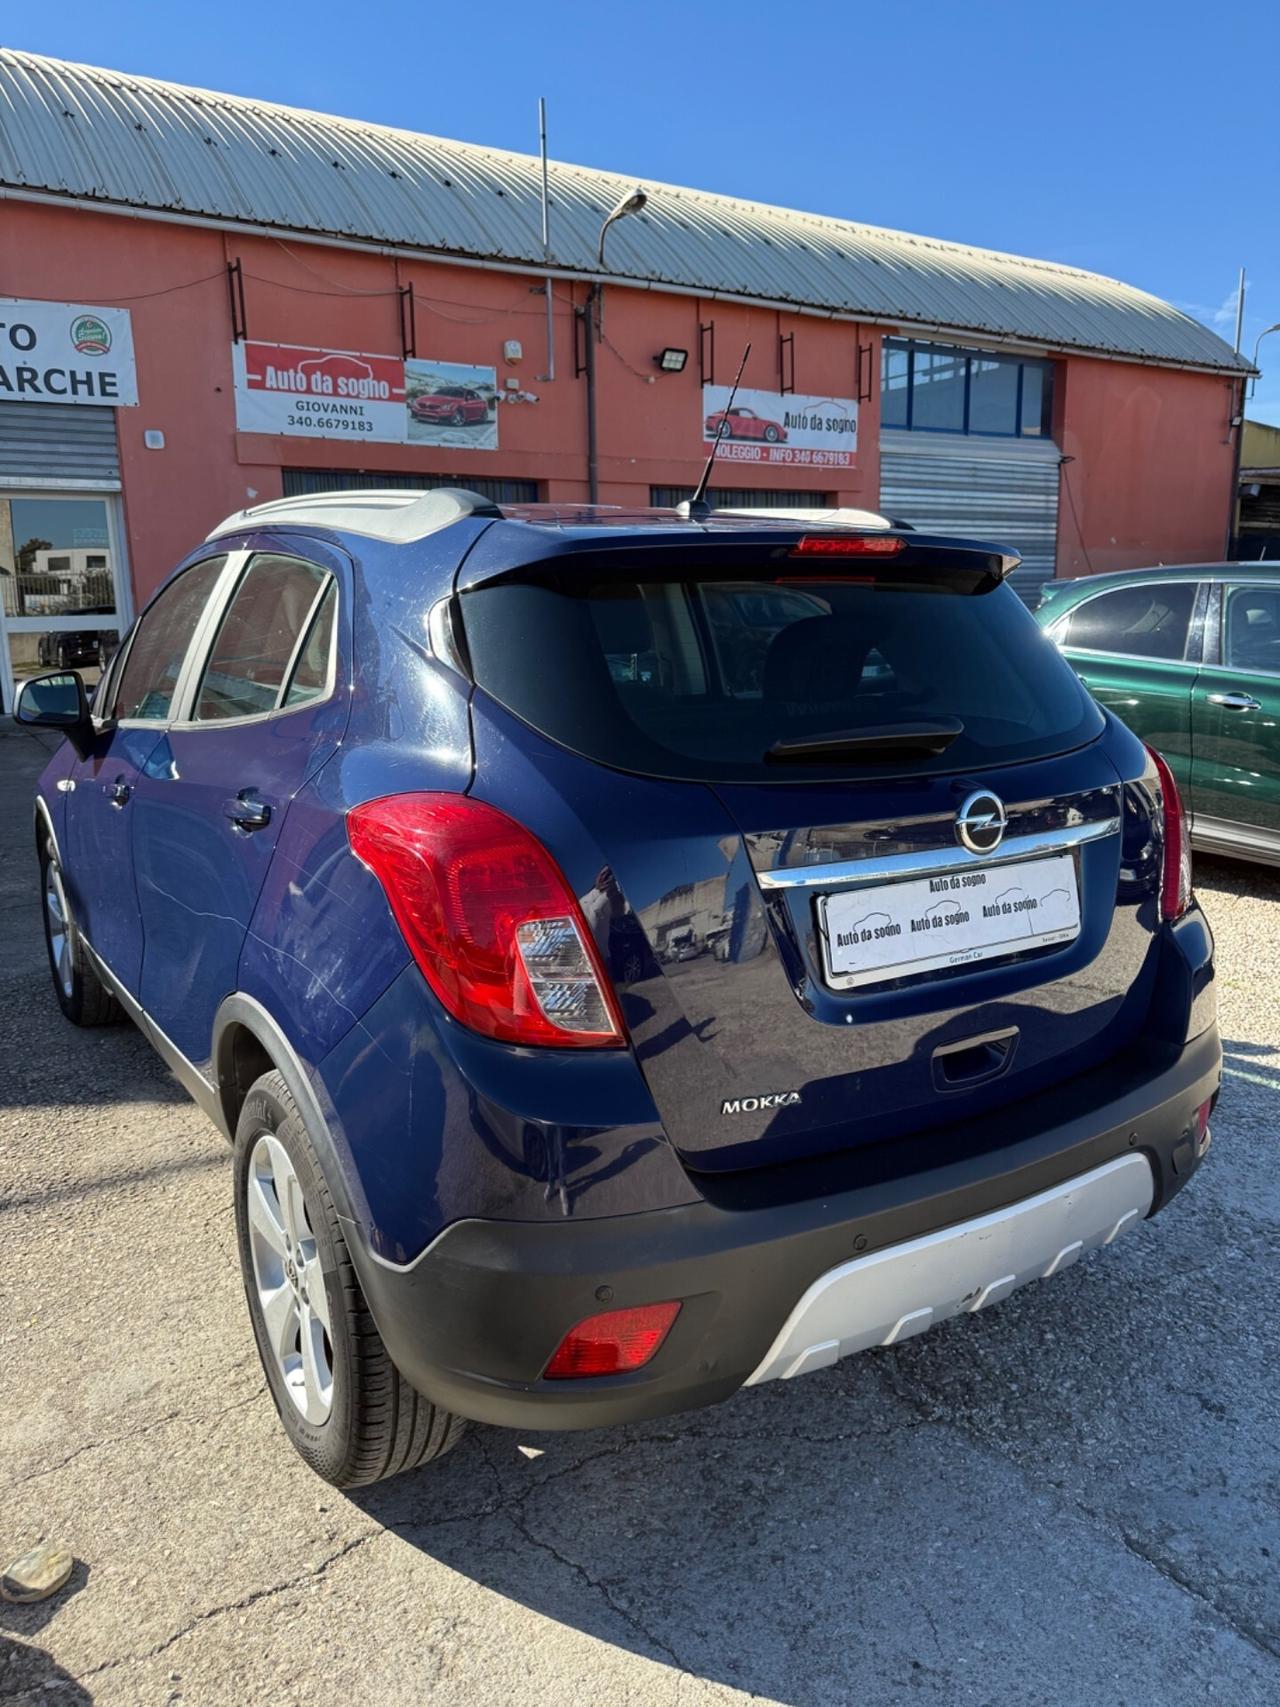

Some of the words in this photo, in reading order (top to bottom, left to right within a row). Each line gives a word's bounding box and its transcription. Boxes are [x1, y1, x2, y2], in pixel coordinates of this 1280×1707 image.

[265, 365, 307, 392] Auto
[311, 371, 333, 394] da
[337, 376, 390, 399] sogno
[295, 400, 365, 416] GIOVANNI
[287, 415, 373, 432] 340.6679183
[784, 411, 808, 430] Auto
[810, 414, 823, 431] da
[825, 417, 857, 434] sogno
[769, 447, 793, 463] INFO
[794, 449, 811, 464] 340
[812, 451, 850, 466] 6679183
[930, 878, 949, 894] Auto
[950, 875, 961, 890] da
[961, 873, 987, 888] sogno
[982, 903, 1001, 919] Auto
[1001, 901, 1012, 915] da
[911, 917, 931, 933] Auto
[932, 914, 944, 929] da
[944, 910, 970, 926] sogno
[837, 931, 860, 948] Auto
[860, 928, 873, 943] da
[722, 1091, 802, 1115] MOKKA
